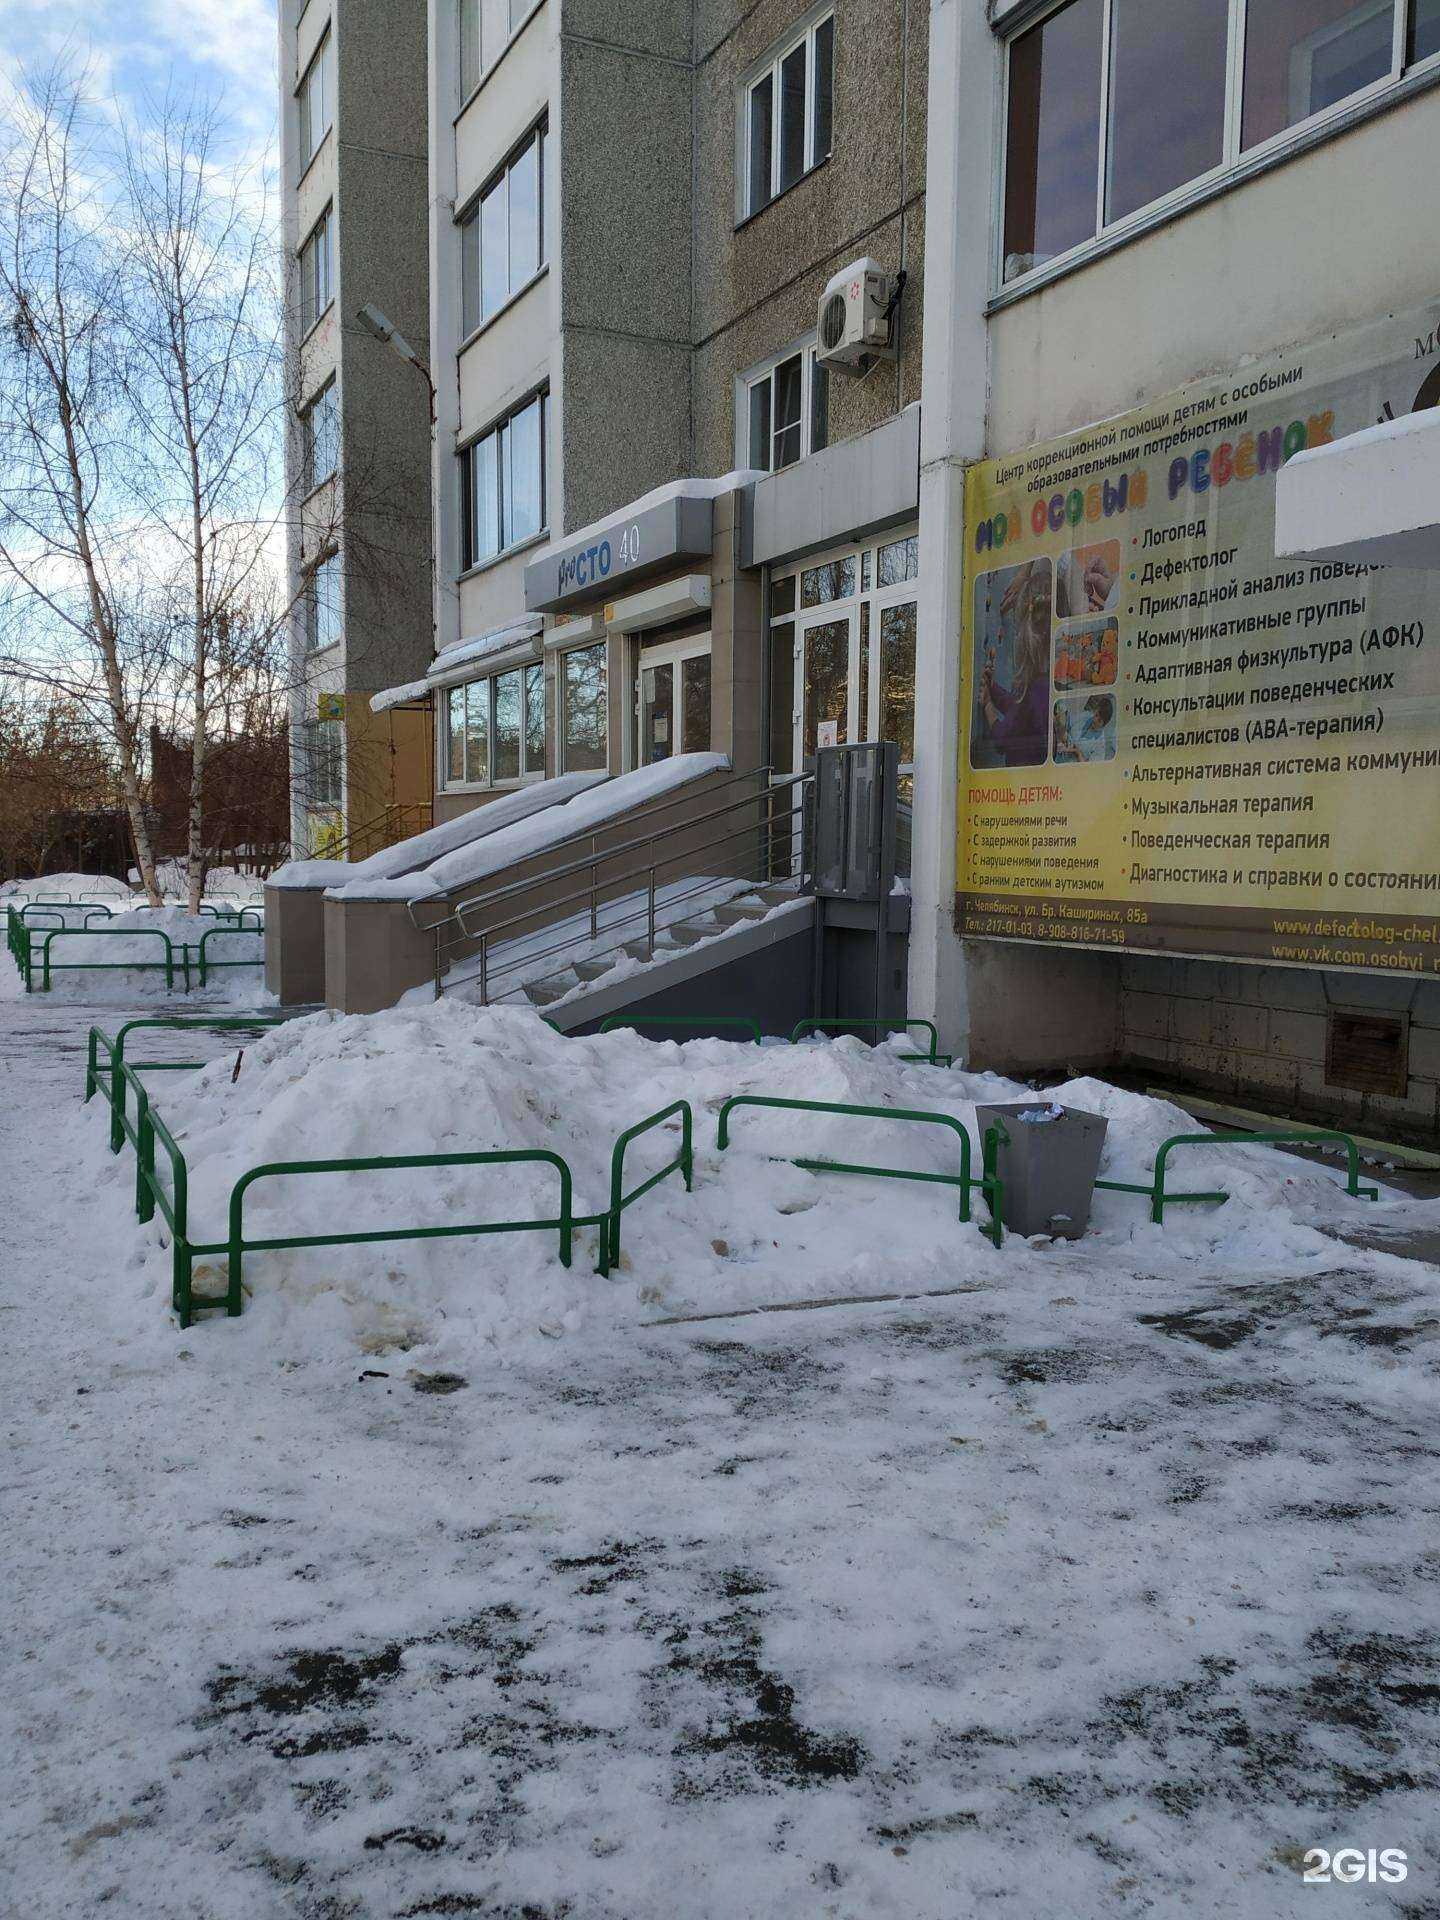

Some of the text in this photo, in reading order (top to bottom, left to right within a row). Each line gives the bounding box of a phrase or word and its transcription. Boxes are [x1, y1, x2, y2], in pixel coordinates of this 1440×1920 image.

[996, 366, 1303, 485] Центр коррекционной помощи детям с особыми
[1027, 410, 1248, 493] образовательными потребностями
[620, 525, 640, 566] 40
[1142, 519, 1207, 549] Логопед
[1141, 548, 1238, 586] Дефектолог
[1139, 579, 1238, 618] Прикладной
[1242, 569, 1305, 596] анализ
[1137, 597, 1366, 649] Коммуникативные группы
[1135, 621, 1424, 684] Адаптивная физкультура (АФК)
[1133, 672, 1395, 717] Консультации поведенческих
[1131, 707, 1384, 750] специалистов (АВА-терапия)
[1132, 749, 1440, 785] Альтернативная система коммуни
[968, 786, 1063, 805] ПОМОЩЬ ДЕТЯМ:
[1131, 796, 1314, 820] Музыкальная терапия
[973, 815, 1068, 829] С нарушениями речи
[973, 834, 1077, 849] С задержкой развития
[1131, 830, 1330, 853] Поведенческая терапия
[972, 853, 1099, 870] С нарушениями поведения
[1130, 862, 1440, 890] Диагностика и справки о состояни
[979, 875, 1010, 888] ранним
[1012, 877, 1052, 889] детским
[1055, 878, 1104, 892] аутизмом
[975, 899, 1022, 916] Челябинск,
[1024, 905, 1039, 918] ул.
[1041, 903, 1056, 919] Бр.
[1059, 904, 1123, 924] Кашириных,
[1127, 908, 1148, 923] 85а
[965, 916, 984, 931] Тел.:
[1038, 923, 1125, 944] 8-908-816-71-59
